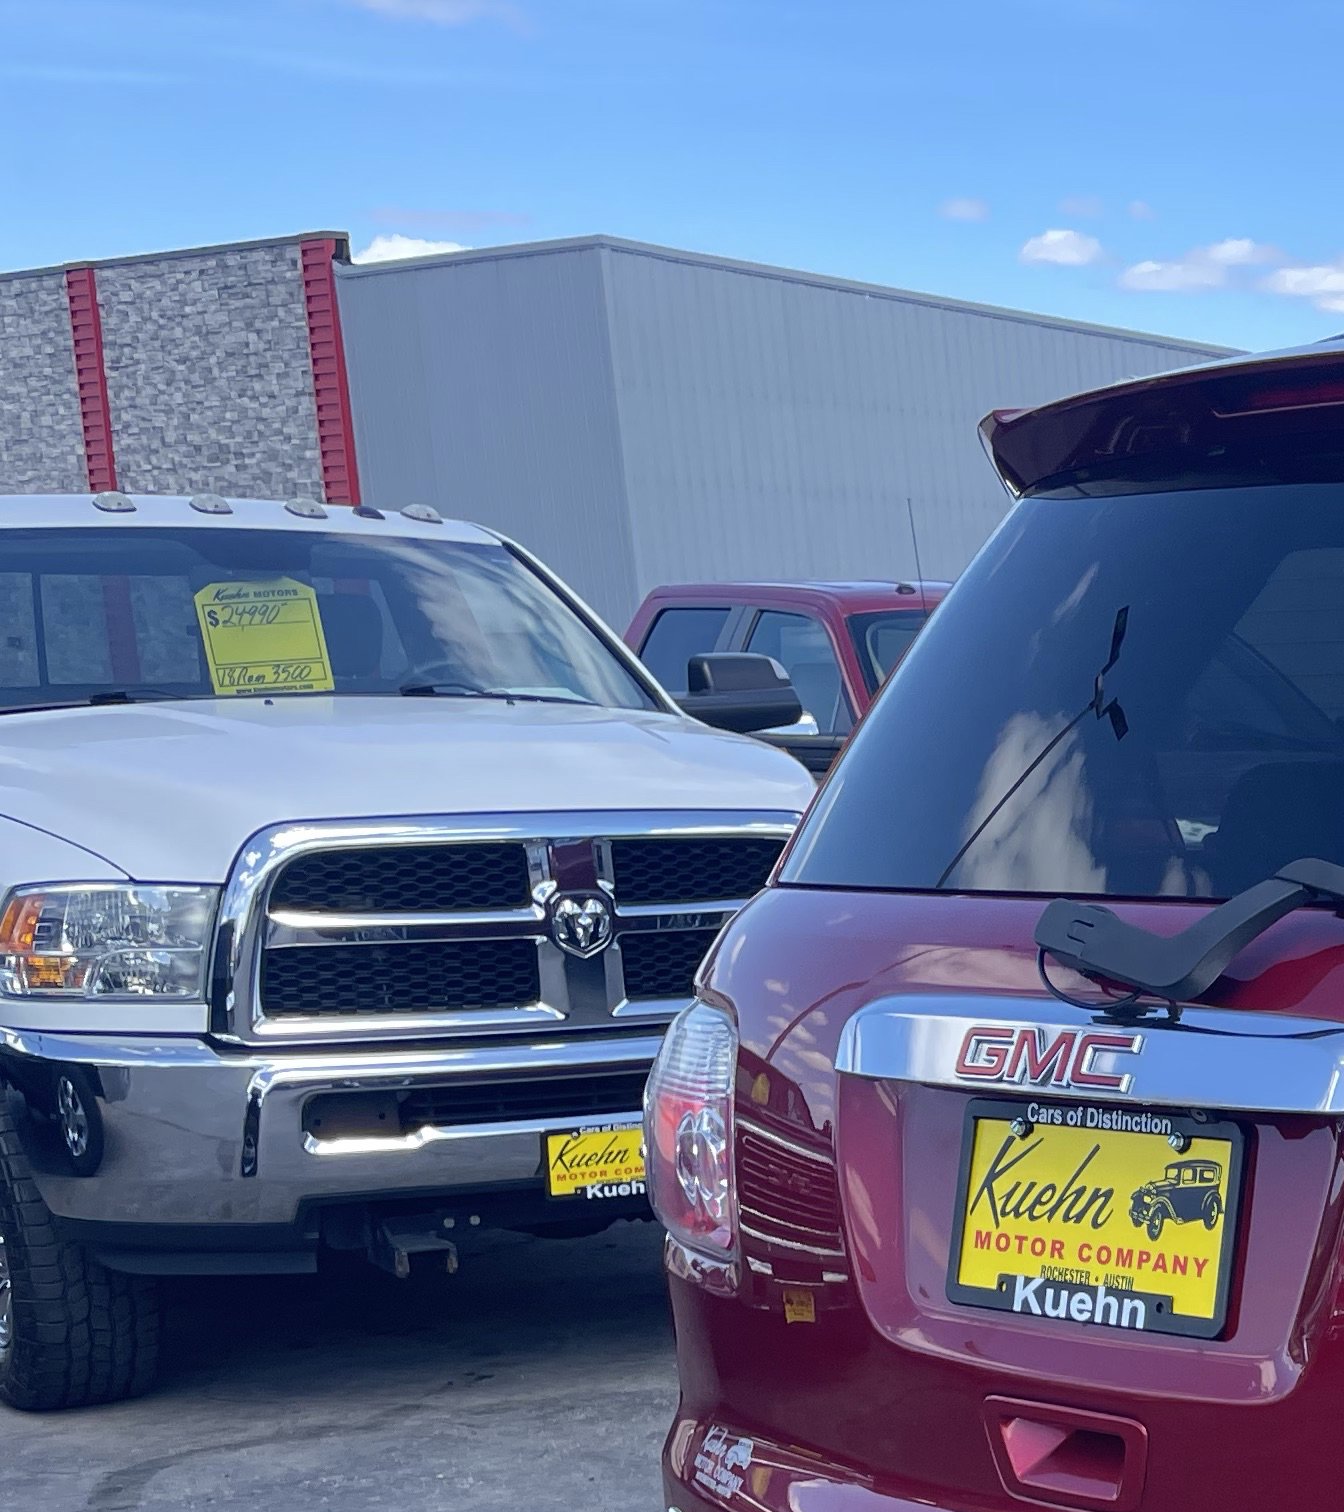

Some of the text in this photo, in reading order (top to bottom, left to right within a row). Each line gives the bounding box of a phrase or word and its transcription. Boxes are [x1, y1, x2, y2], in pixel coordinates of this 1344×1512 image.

[253, 589, 299, 598] MOTORS
[272, 664, 312, 683] 3500
[955, 1024, 1145, 1094] GMC
[1027, 1102, 1172, 1135] Cars of Distinction
[551, 1135, 630, 1173] Kuehn
[556, 1169, 608, 1182] MOTOR
[970, 1135, 1114, 1230] Kuehn
[974, 1229, 1210, 1278] MOTOR COMPANY
[1040, 1265, 1135, 1291] ROCHESTER AUSTIN
[1012, 1274, 1146, 1330] Kuehn
